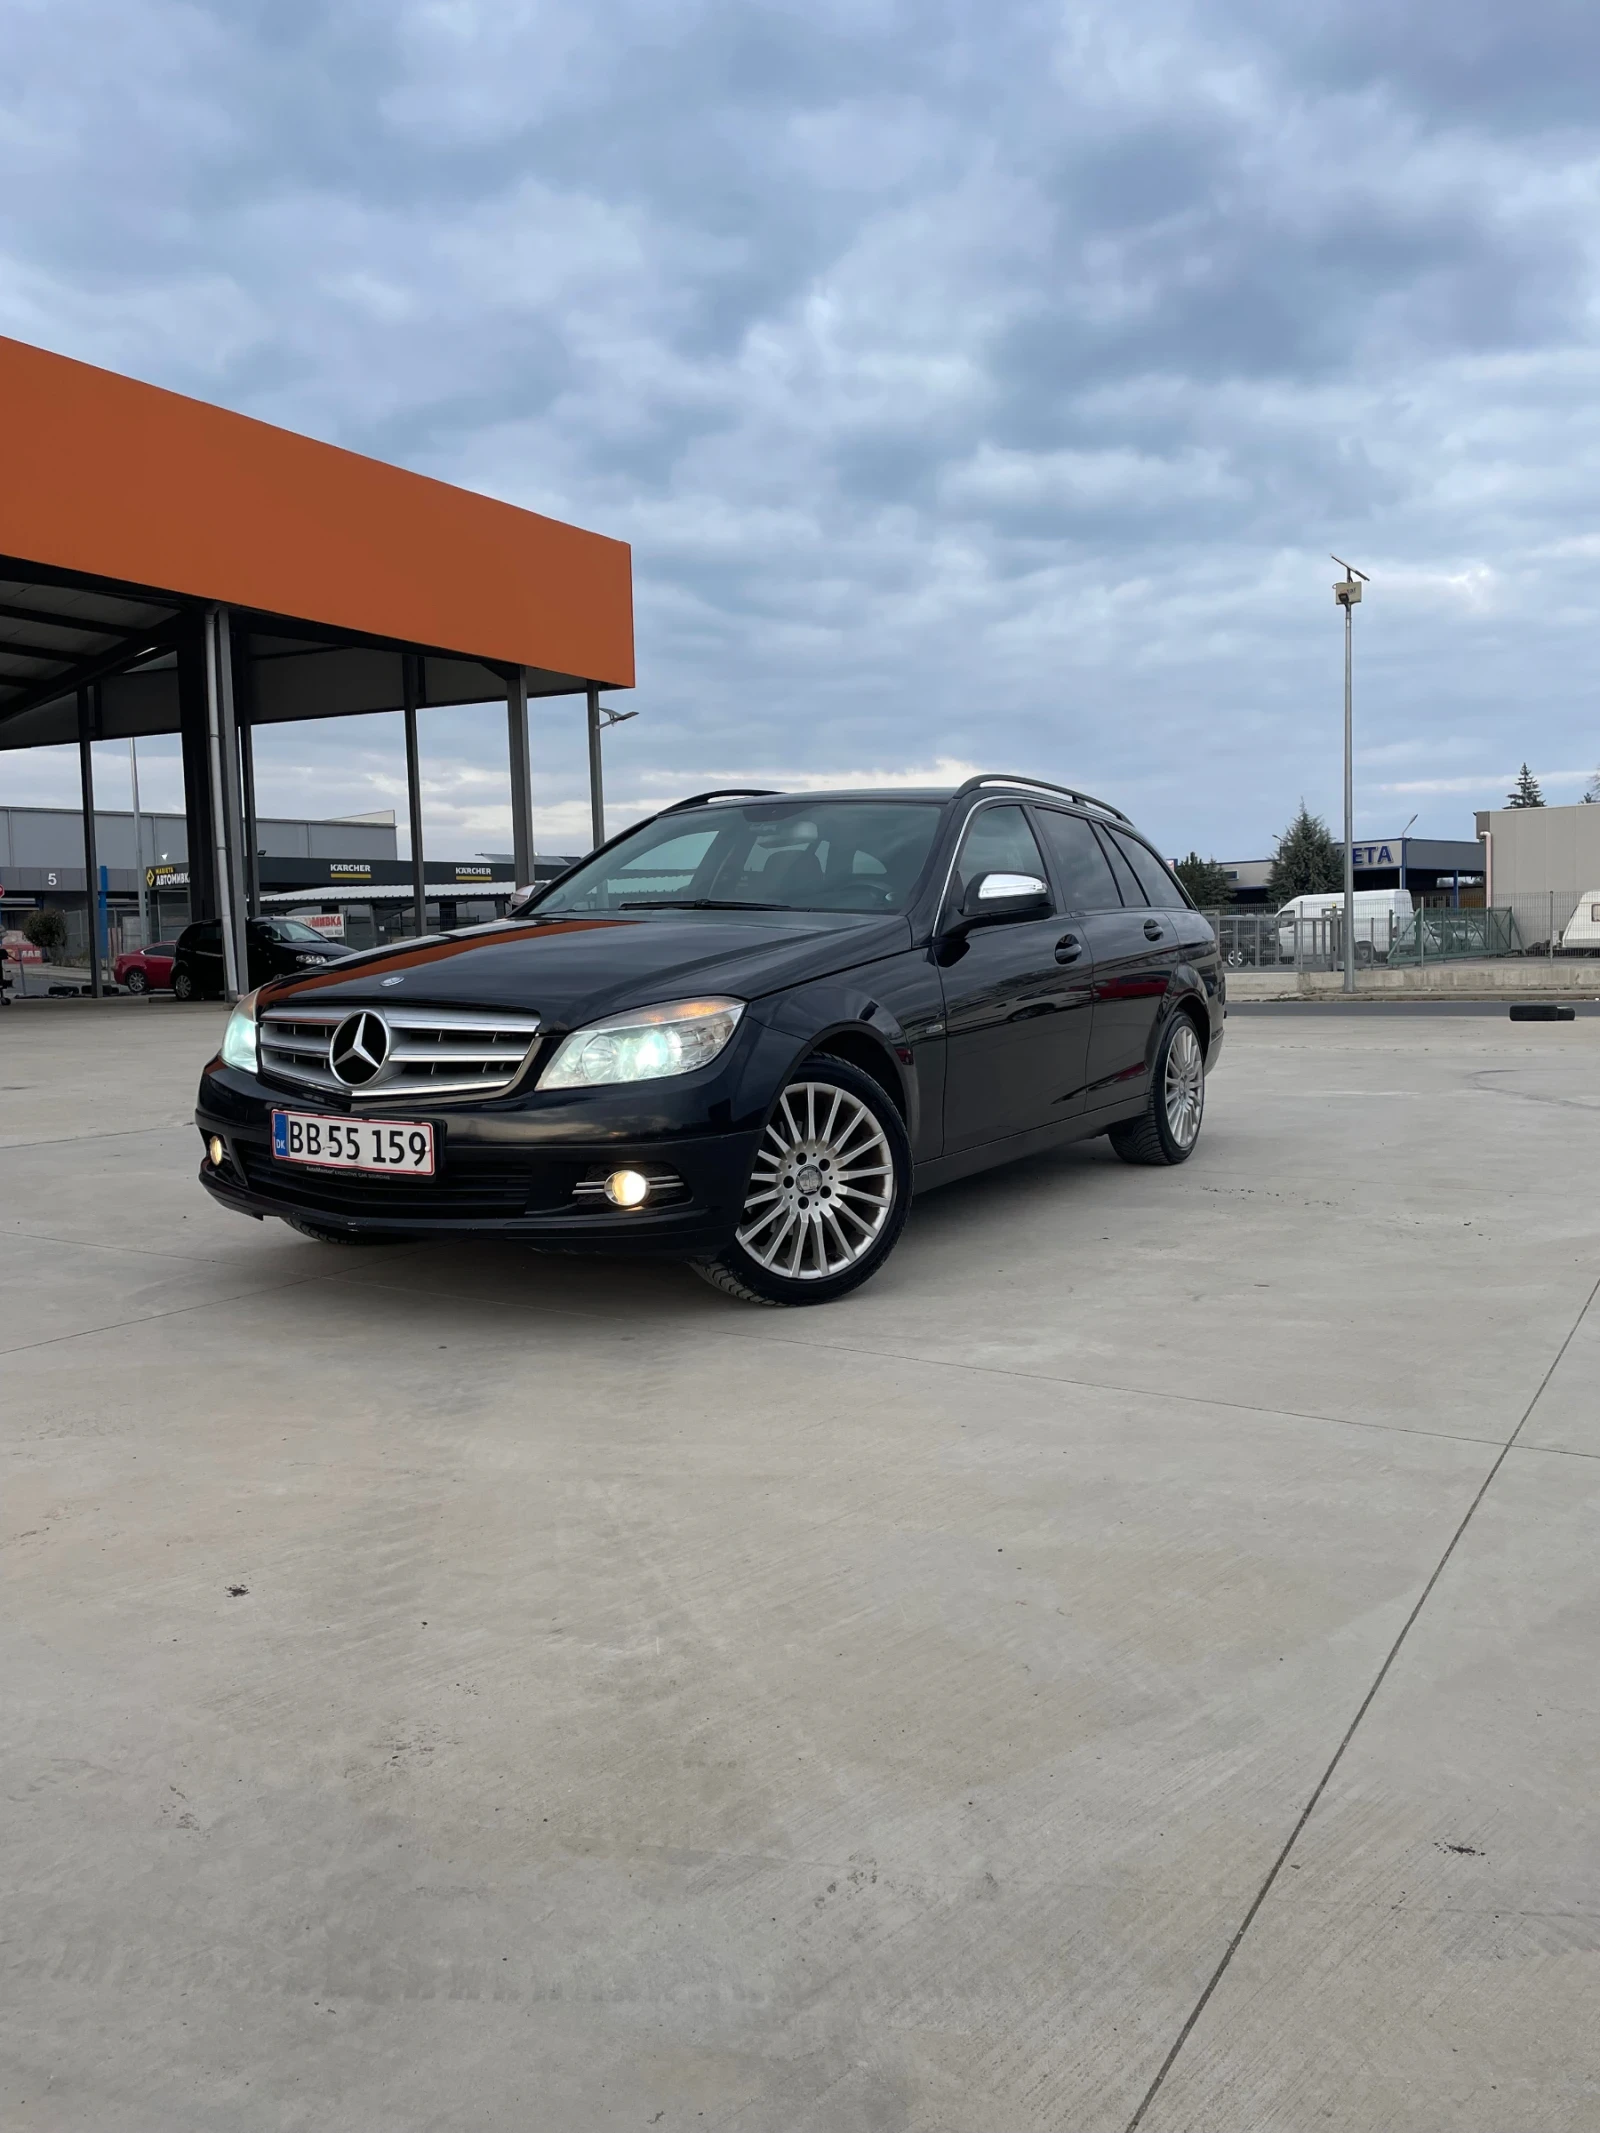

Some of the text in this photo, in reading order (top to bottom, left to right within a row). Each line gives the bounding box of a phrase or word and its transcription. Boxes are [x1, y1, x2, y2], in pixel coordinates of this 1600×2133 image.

[48, 873, 57, 885] 5
[275, 1139, 286, 1149] DK
[289, 1121, 427, 1166] BB 55 159
